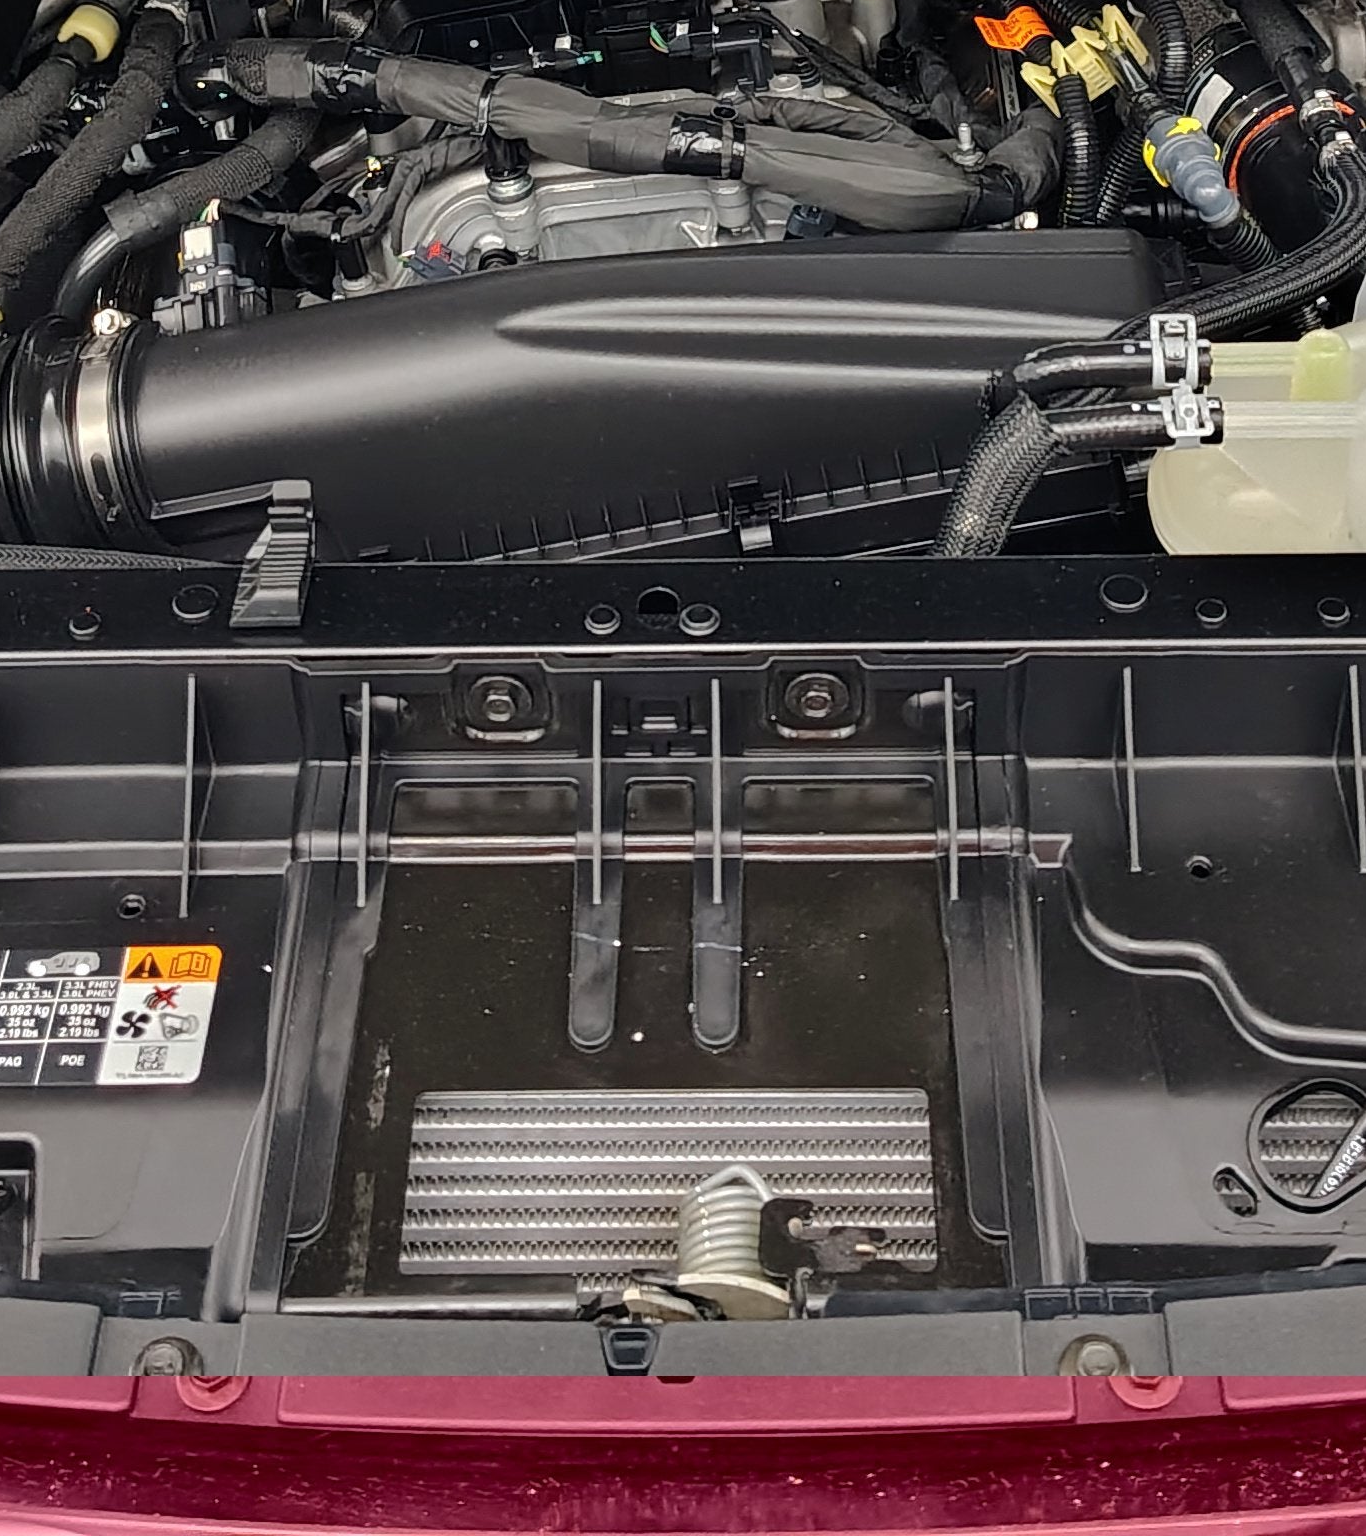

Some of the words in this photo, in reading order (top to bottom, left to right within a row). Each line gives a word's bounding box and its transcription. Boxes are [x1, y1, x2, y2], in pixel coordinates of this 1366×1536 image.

[33, 1003, 50, 1019] kg
[59, 1003, 93, 1016] 0.992
[94, 1003, 111, 1018] kg
[22, 1018, 36, 1026] oz
[82, 1017, 96, 1026] oz
[22, 1028, 39, 1038] lbs
[58, 1027, 82, 1037] 2.19
[82, 1027, 100, 1037] lbs
[60, 1054, 86, 1066] POE
